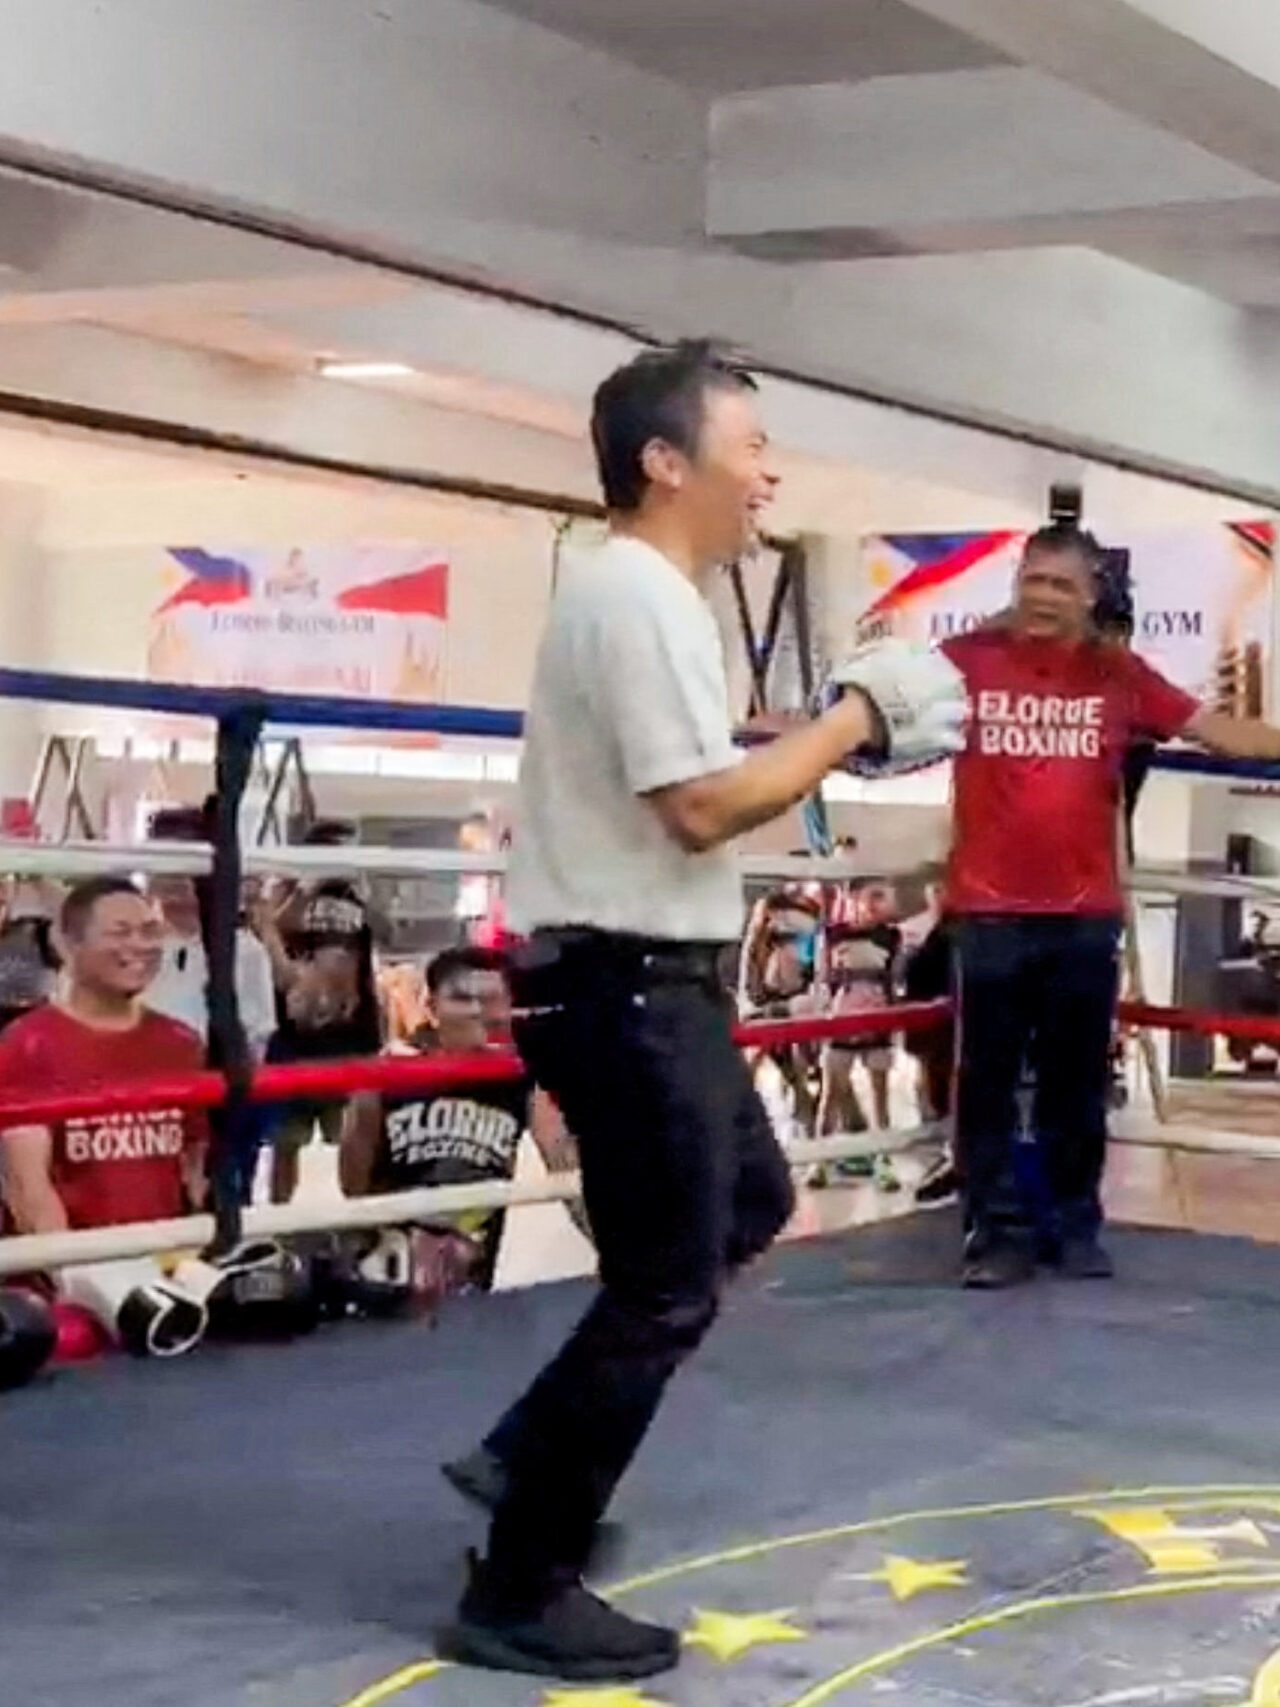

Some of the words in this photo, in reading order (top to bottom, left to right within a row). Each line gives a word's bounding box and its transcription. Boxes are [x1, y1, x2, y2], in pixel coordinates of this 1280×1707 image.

[1142, 611, 1203, 637] GYM
[980, 726, 1100, 757] BOXING
[65, 1124, 184, 1163] BOXING
